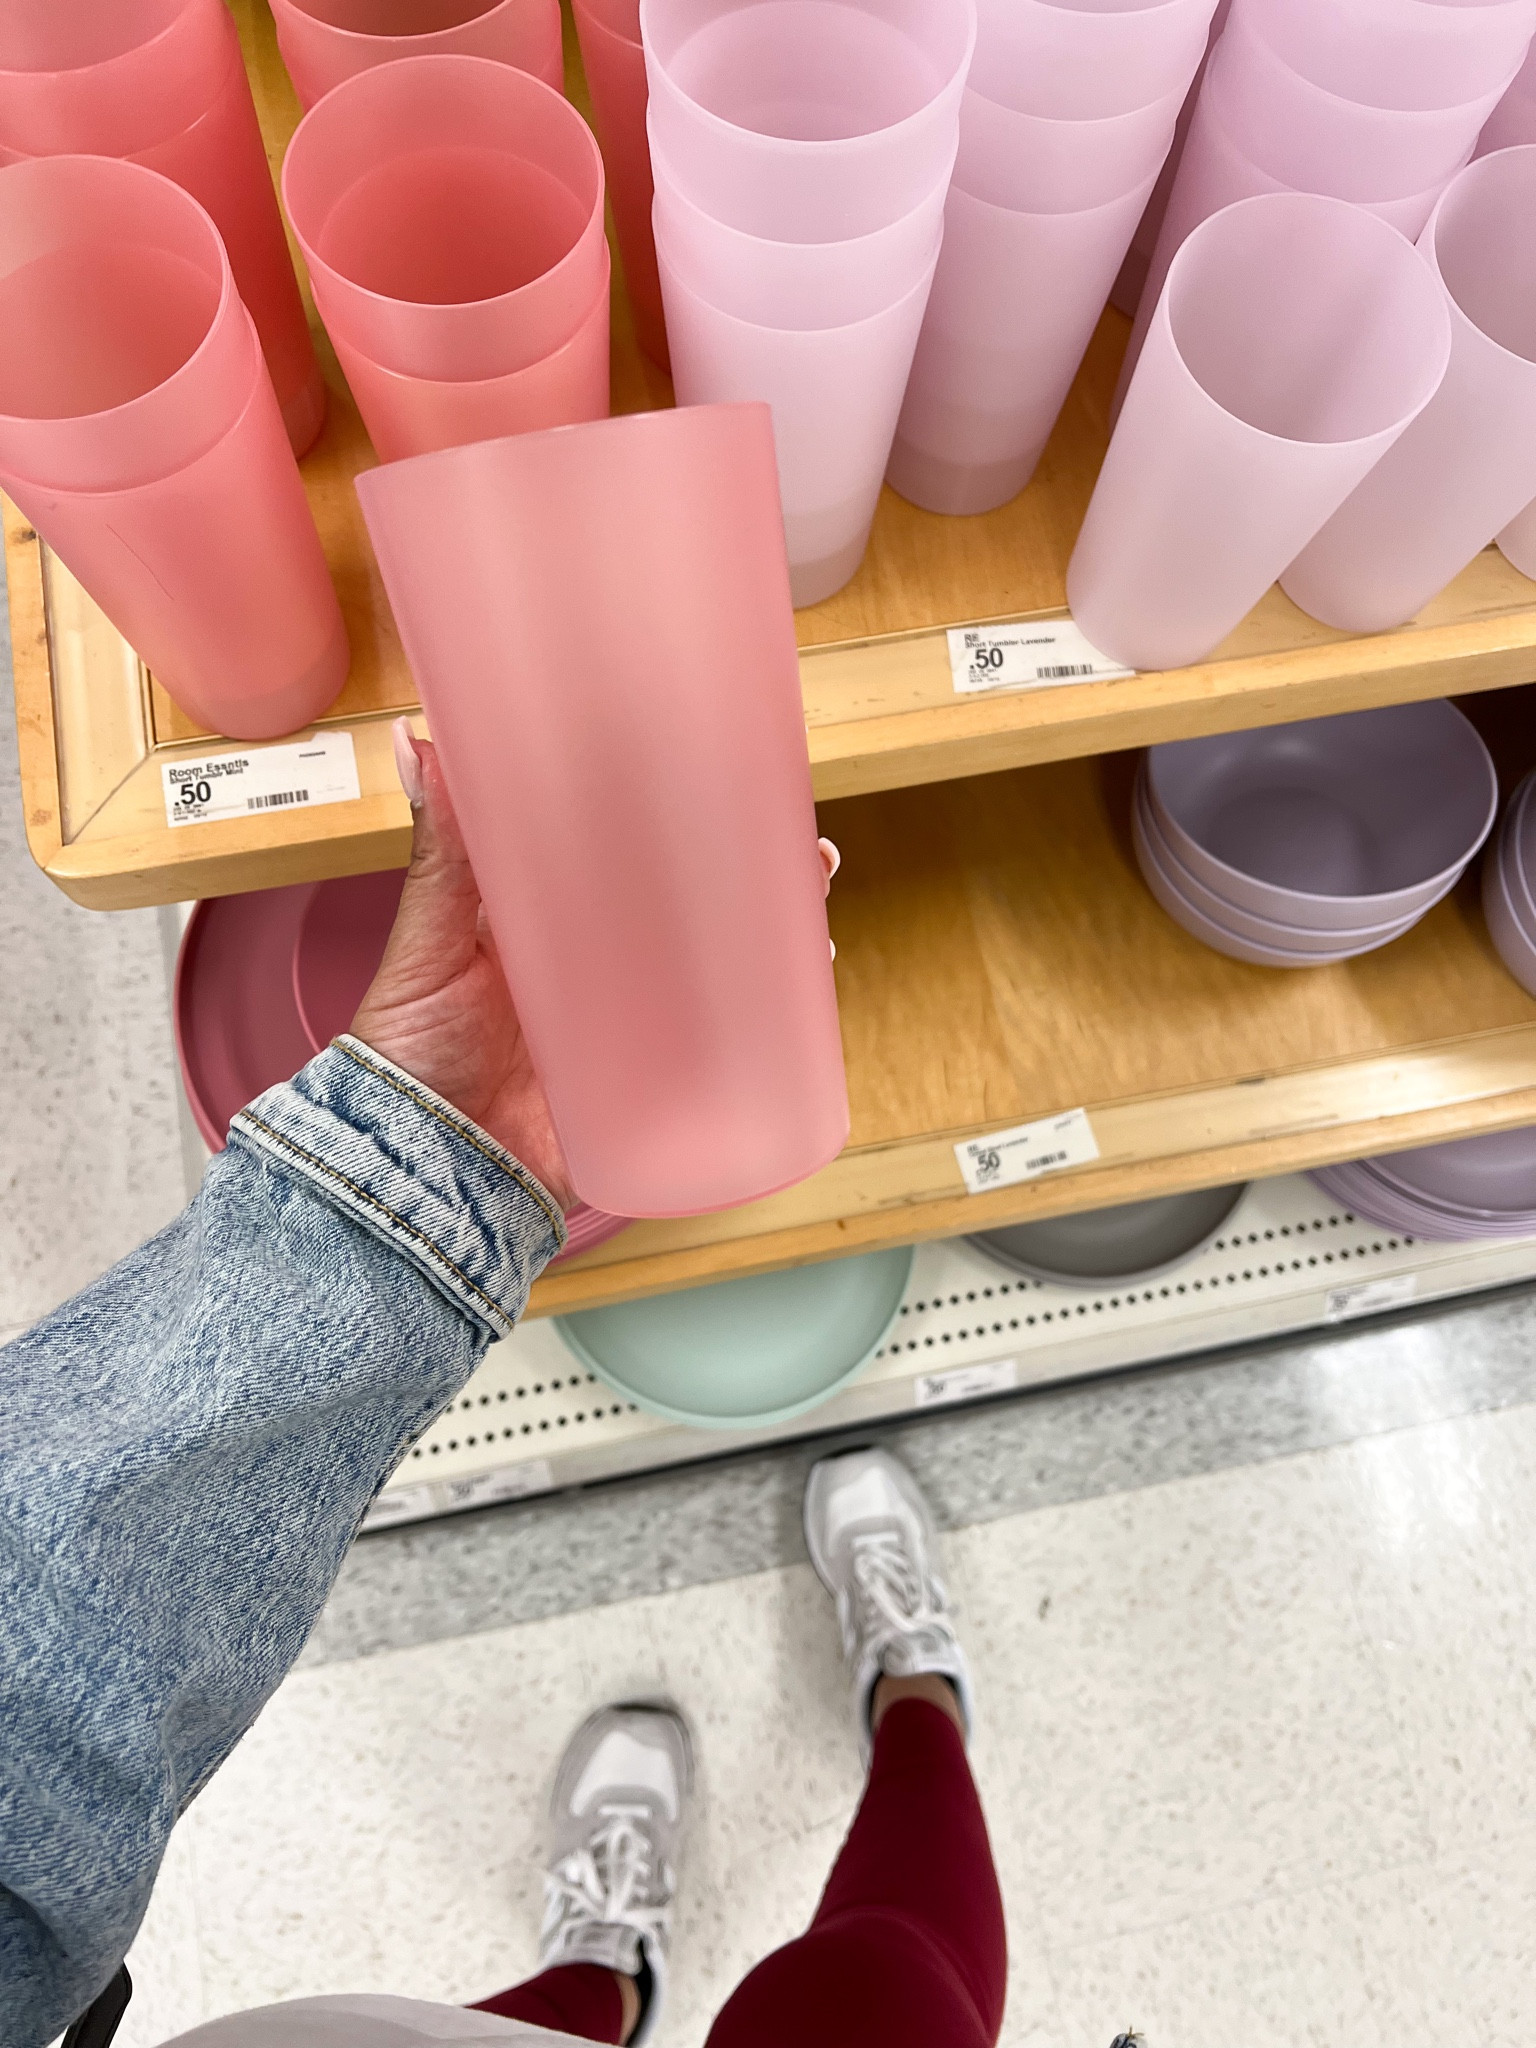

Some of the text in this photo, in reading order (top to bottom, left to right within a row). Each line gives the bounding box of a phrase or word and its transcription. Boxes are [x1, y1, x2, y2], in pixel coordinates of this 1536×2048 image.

[1020, 637, 1056, 645] Lavender
[969, 648, 1004, 669] .50
[169, 767, 203, 777] Room
[174, 781, 212, 806] .50
